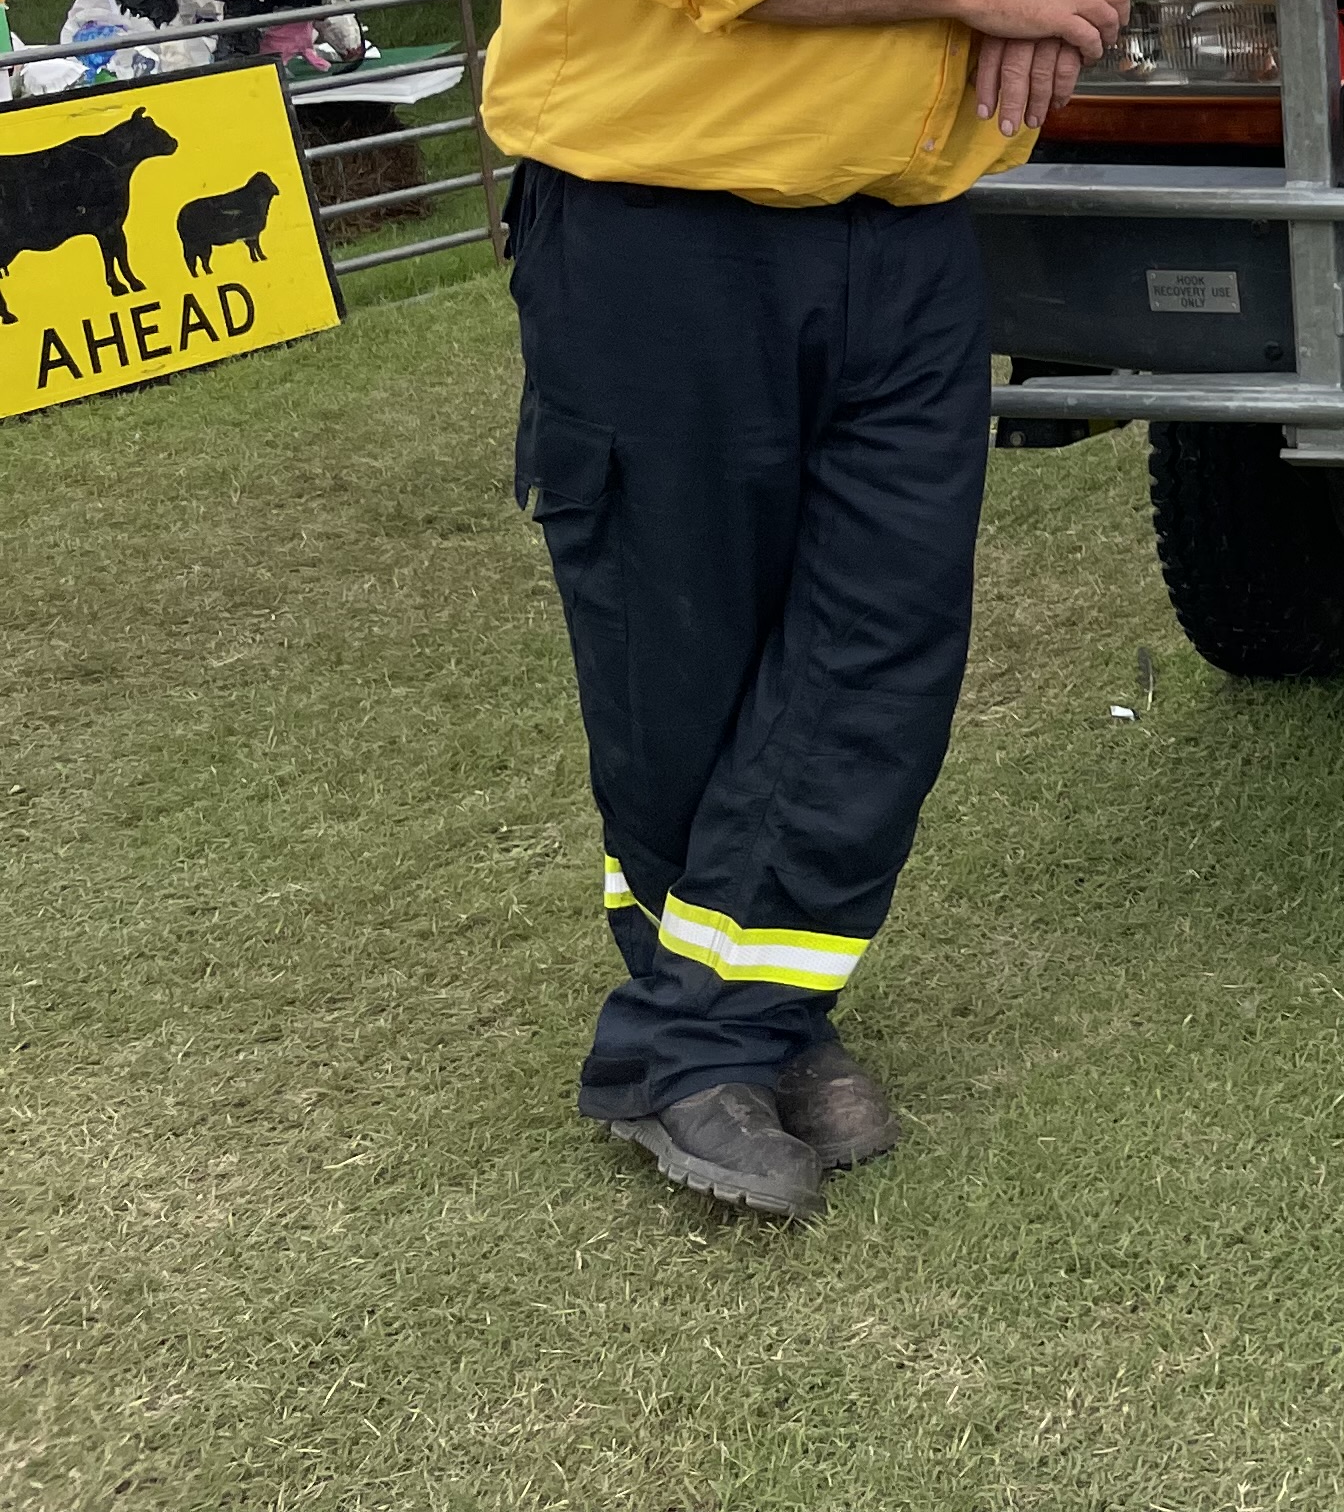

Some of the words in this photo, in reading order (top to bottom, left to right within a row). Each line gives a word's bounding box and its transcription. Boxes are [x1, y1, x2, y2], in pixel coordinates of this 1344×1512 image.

[1176, 275, 1206, 286] HOOK
[1153, 286, 1207, 297] RECOVERY
[1211, 287, 1232, 298] USE
[1181, 297, 1206, 308] ONLY
[37, 282, 255, 389] AHEAD
